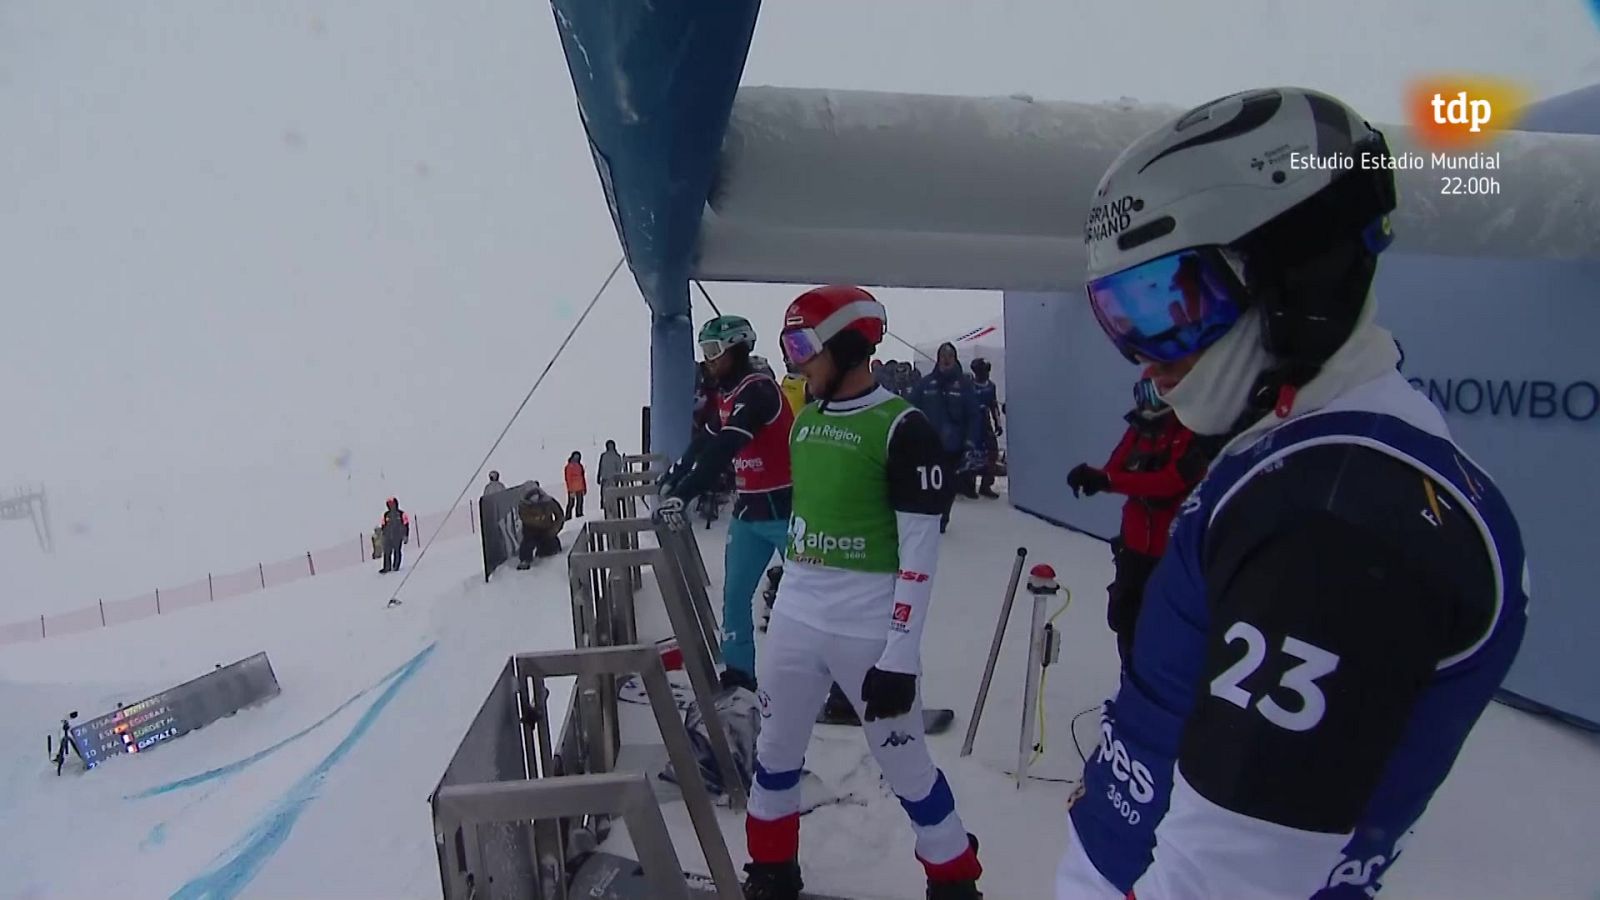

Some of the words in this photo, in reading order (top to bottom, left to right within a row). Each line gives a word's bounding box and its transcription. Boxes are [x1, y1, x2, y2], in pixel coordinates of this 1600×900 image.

[822, 424, 862, 445] Région
[916, 465, 942, 490] 10
[1210, 621, 1340, 731] 23
[1097, 722, 1154, 803] pes
